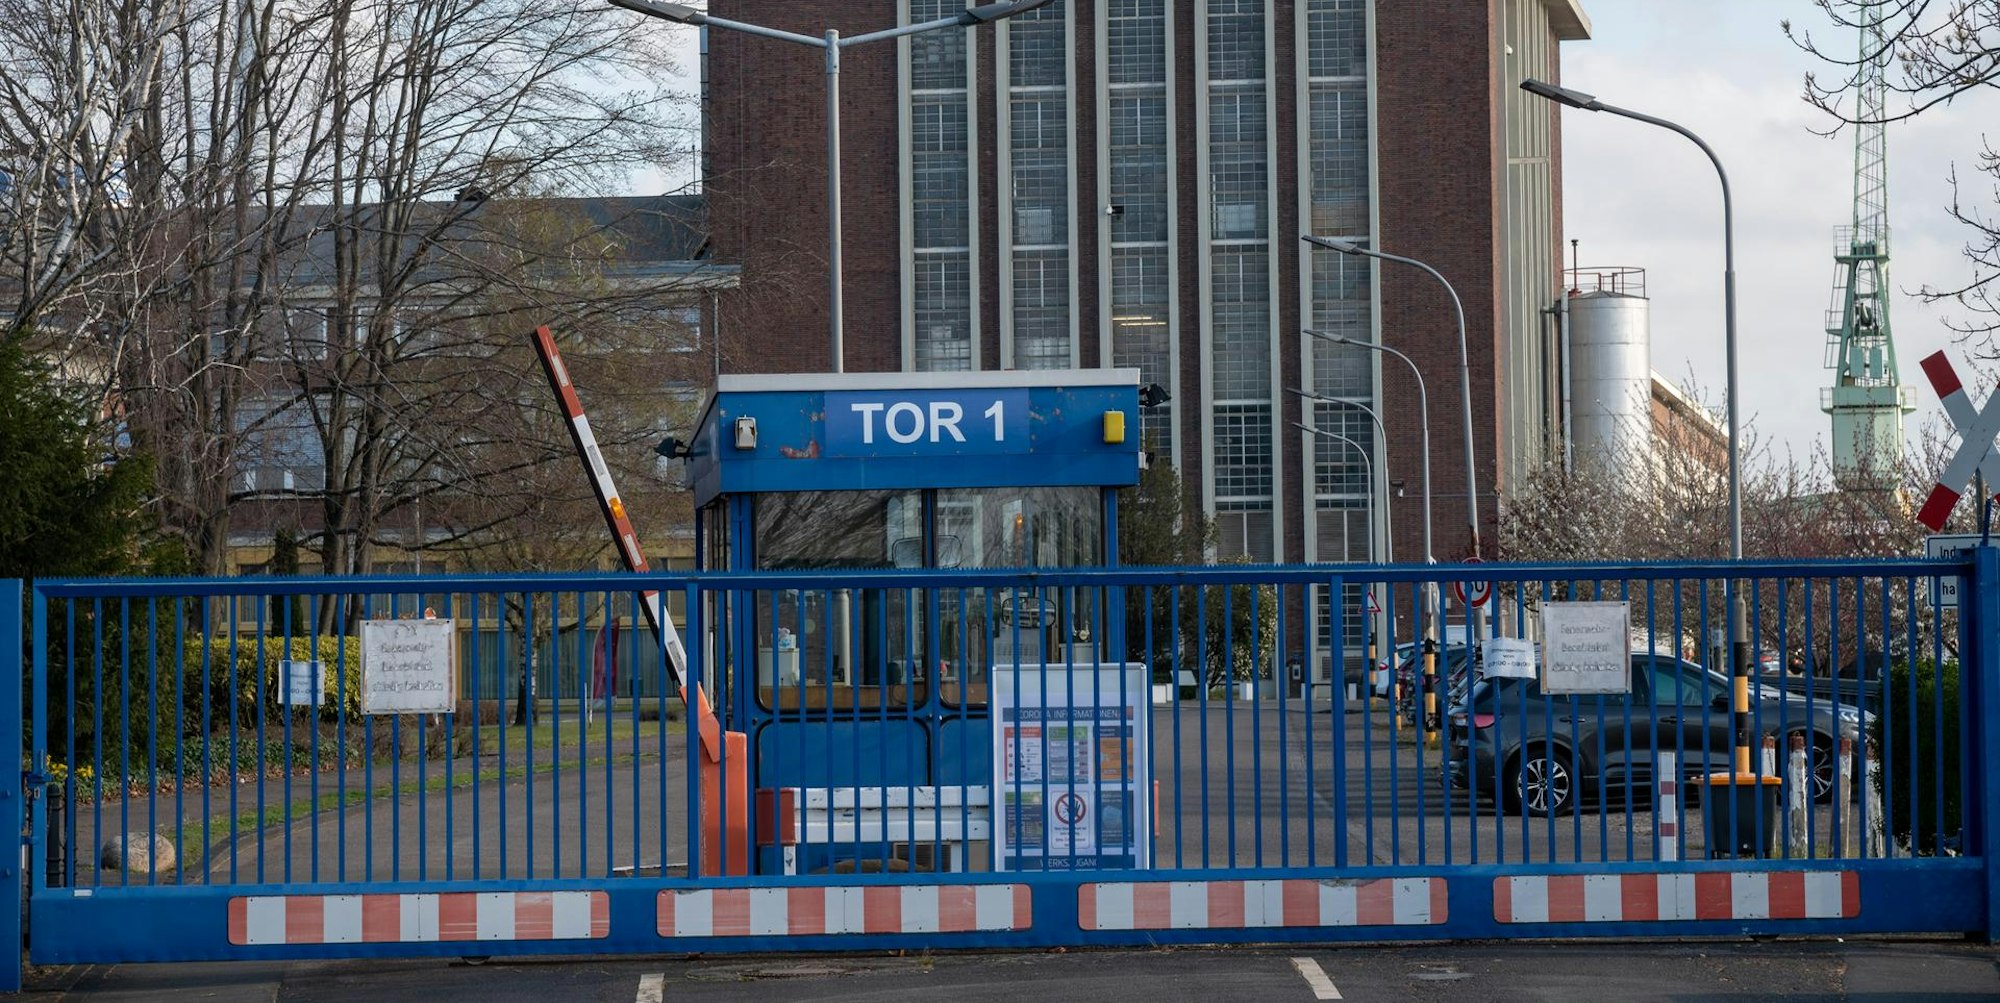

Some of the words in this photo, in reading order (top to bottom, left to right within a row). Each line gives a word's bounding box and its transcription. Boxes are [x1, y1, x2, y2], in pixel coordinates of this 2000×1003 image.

[851, 401, 967, 444] TOR
[984, 400, 1004, 441] 1
[1020, 709, 1052, 720] COROA
[1054, 708, 1118, 719] INFRMATNEN
